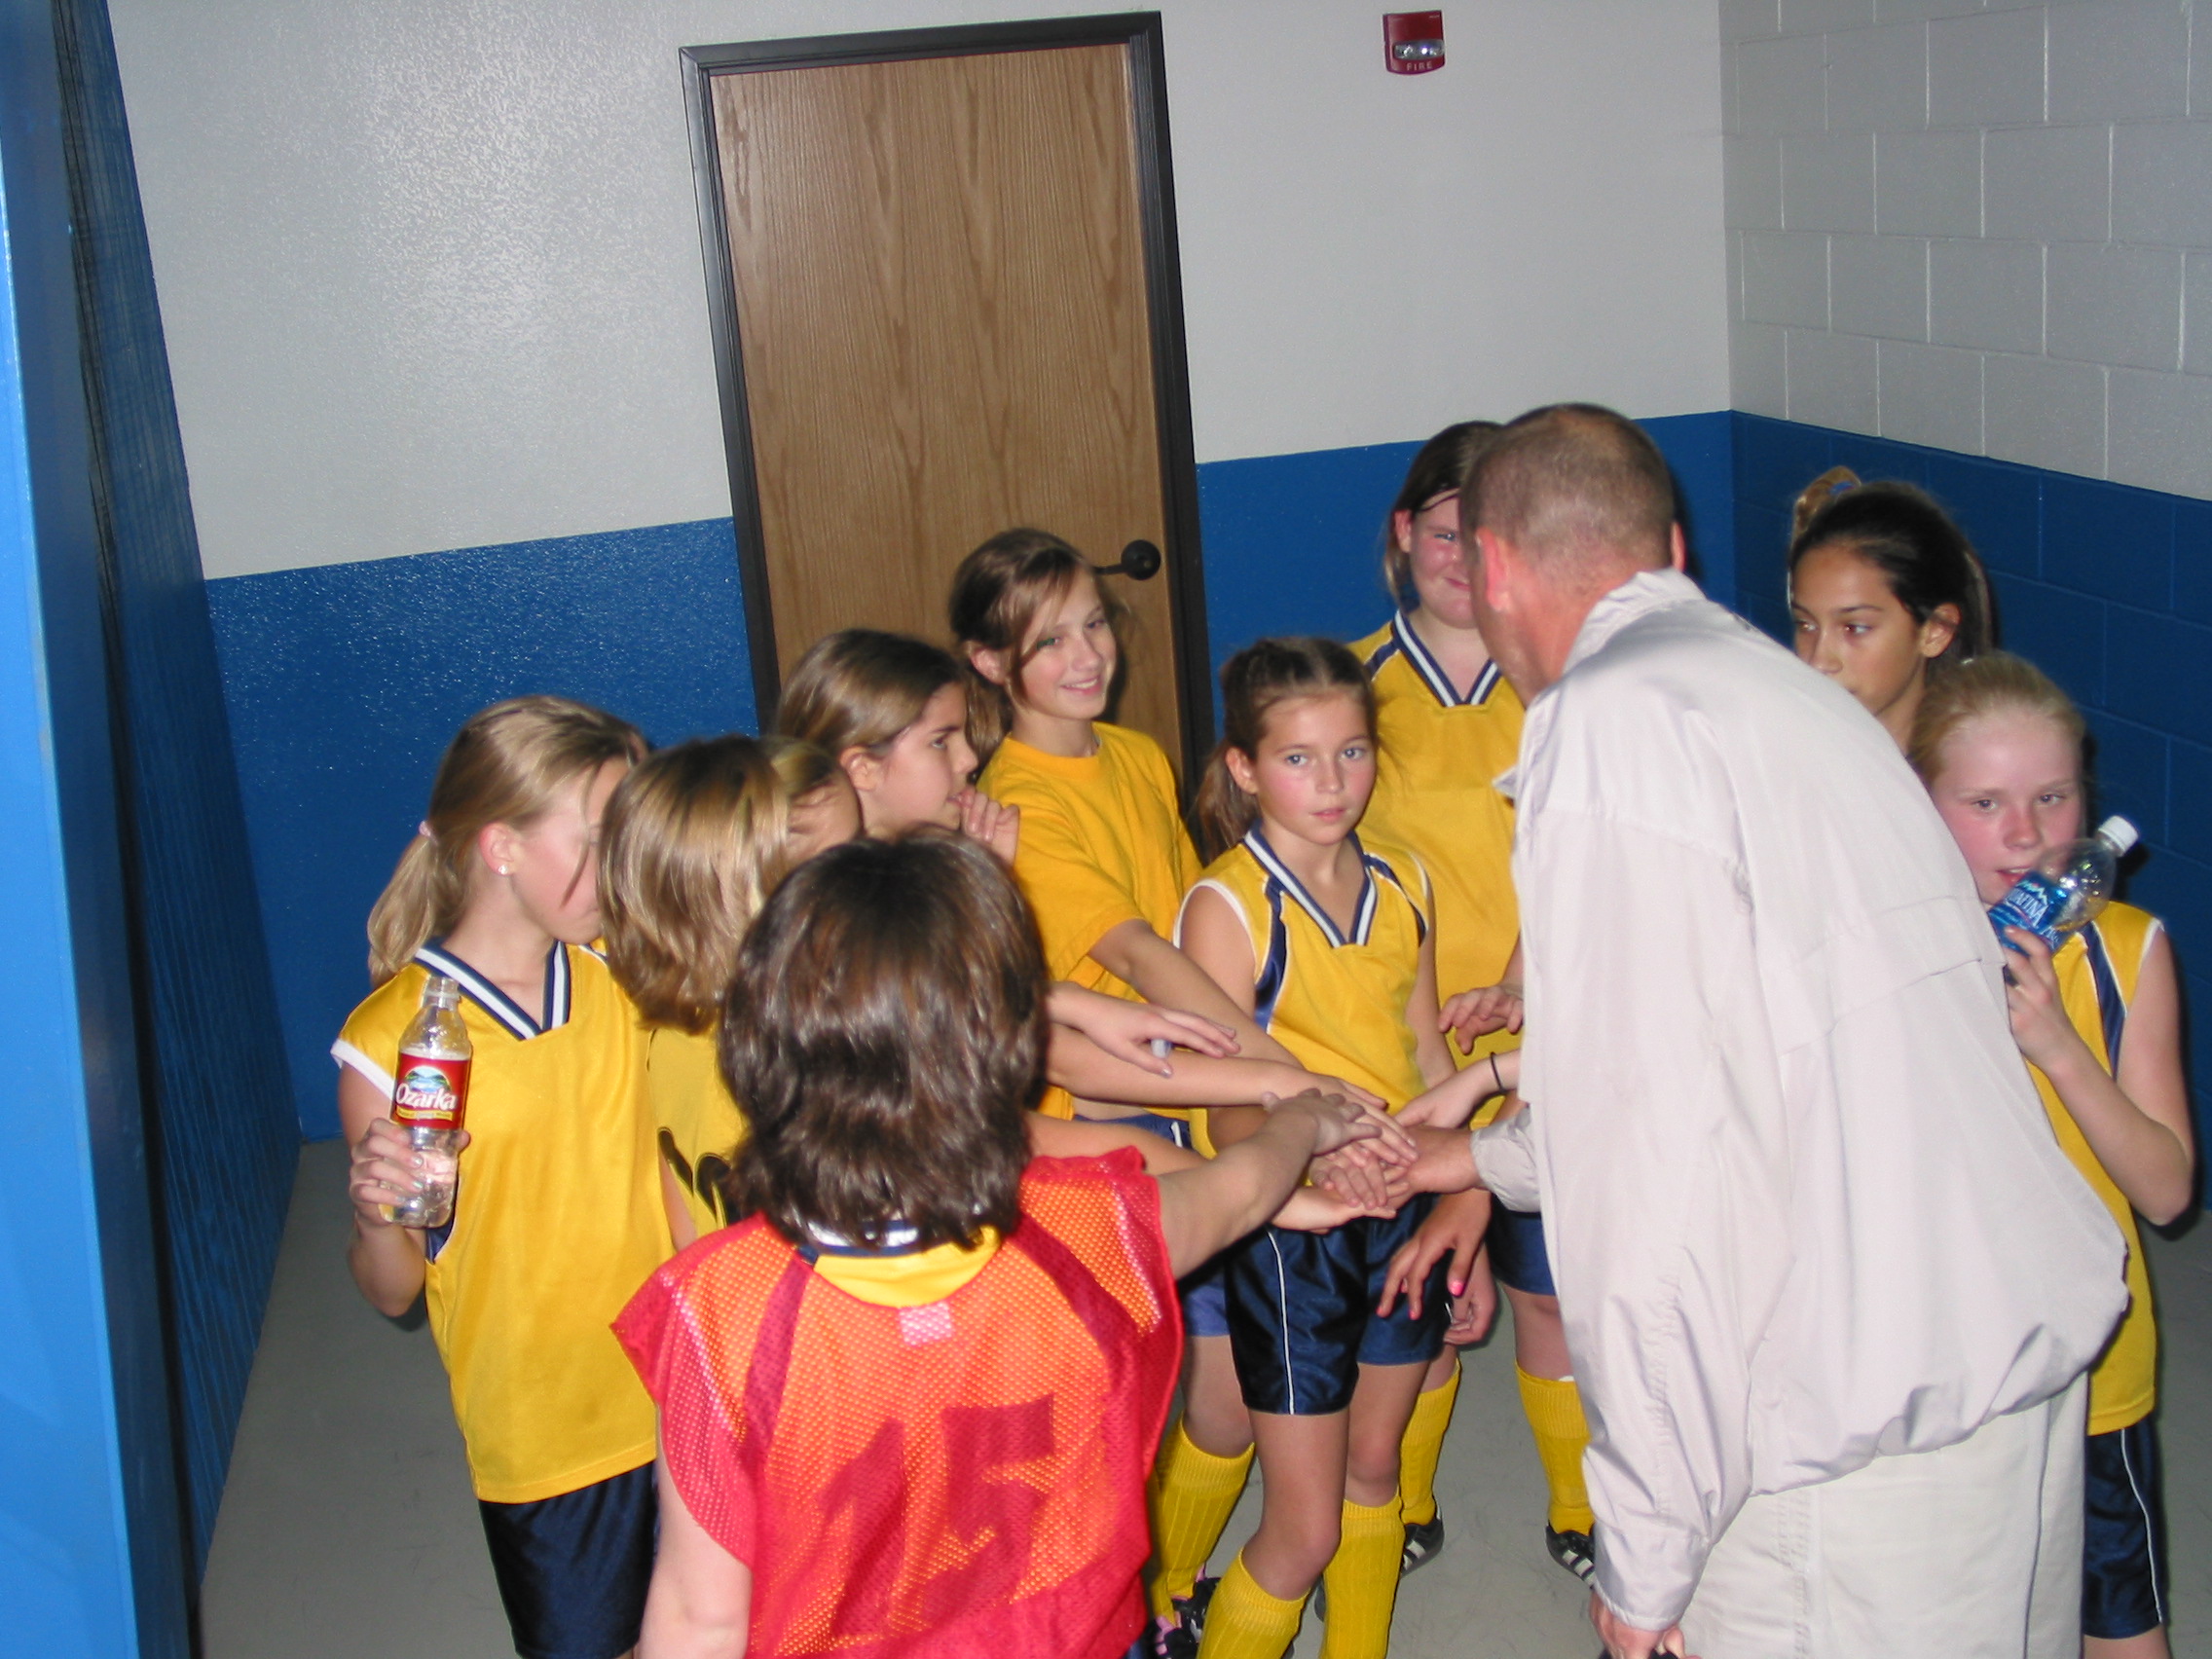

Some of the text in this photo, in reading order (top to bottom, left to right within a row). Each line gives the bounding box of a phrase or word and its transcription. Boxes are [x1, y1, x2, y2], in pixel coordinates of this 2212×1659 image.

[1407, 61, 1432, 71] FIRE
[396, 1083, 456, 1110] Ozarka
[820, 1391, 1054, 1645] 15
